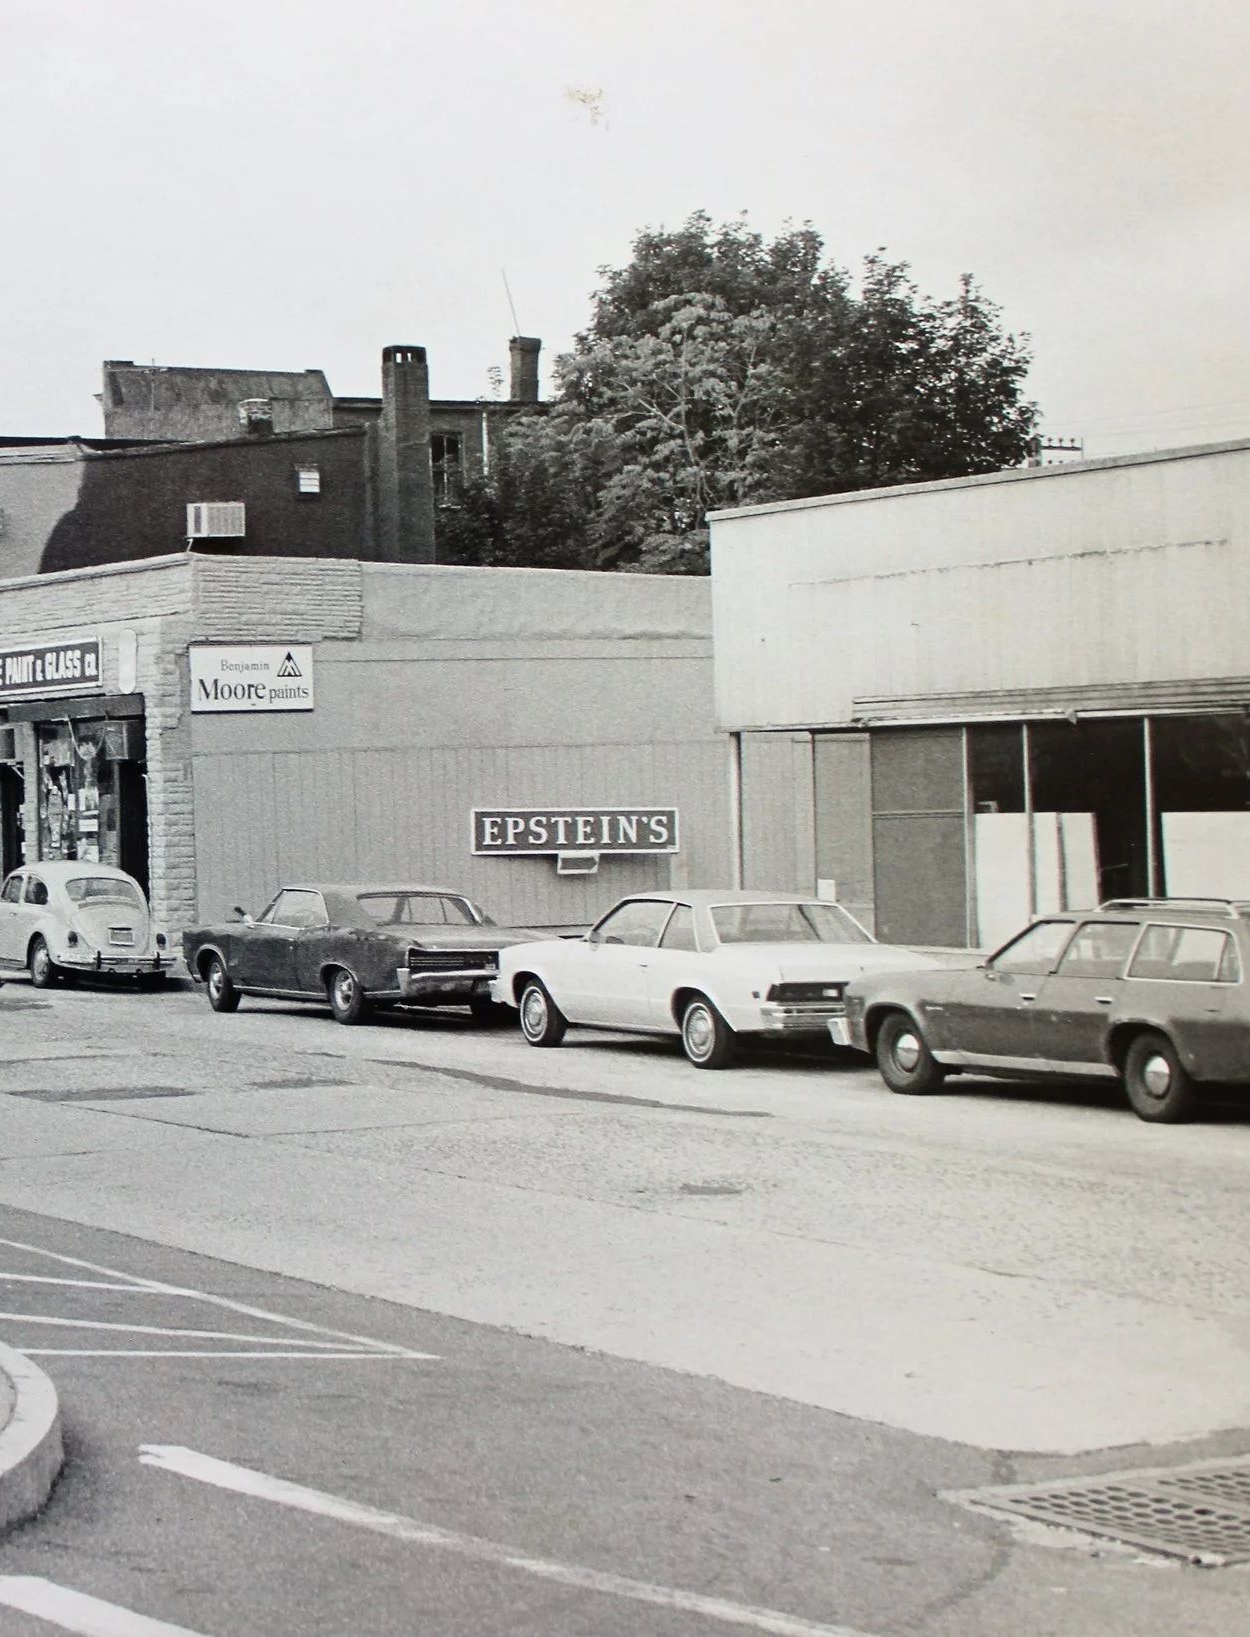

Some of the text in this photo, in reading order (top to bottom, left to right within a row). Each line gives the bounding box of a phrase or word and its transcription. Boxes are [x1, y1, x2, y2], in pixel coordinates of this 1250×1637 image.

[5, 654, 35, 685] PAINT
[35, 659, 44, 682] &
[45, 650, 82, 681] GLASS
[220, 659, 270, 673] Benjamin
[198, 678, 310, 704] Moore paints
[481, 815, 669, 846] EPSTEIN'S
